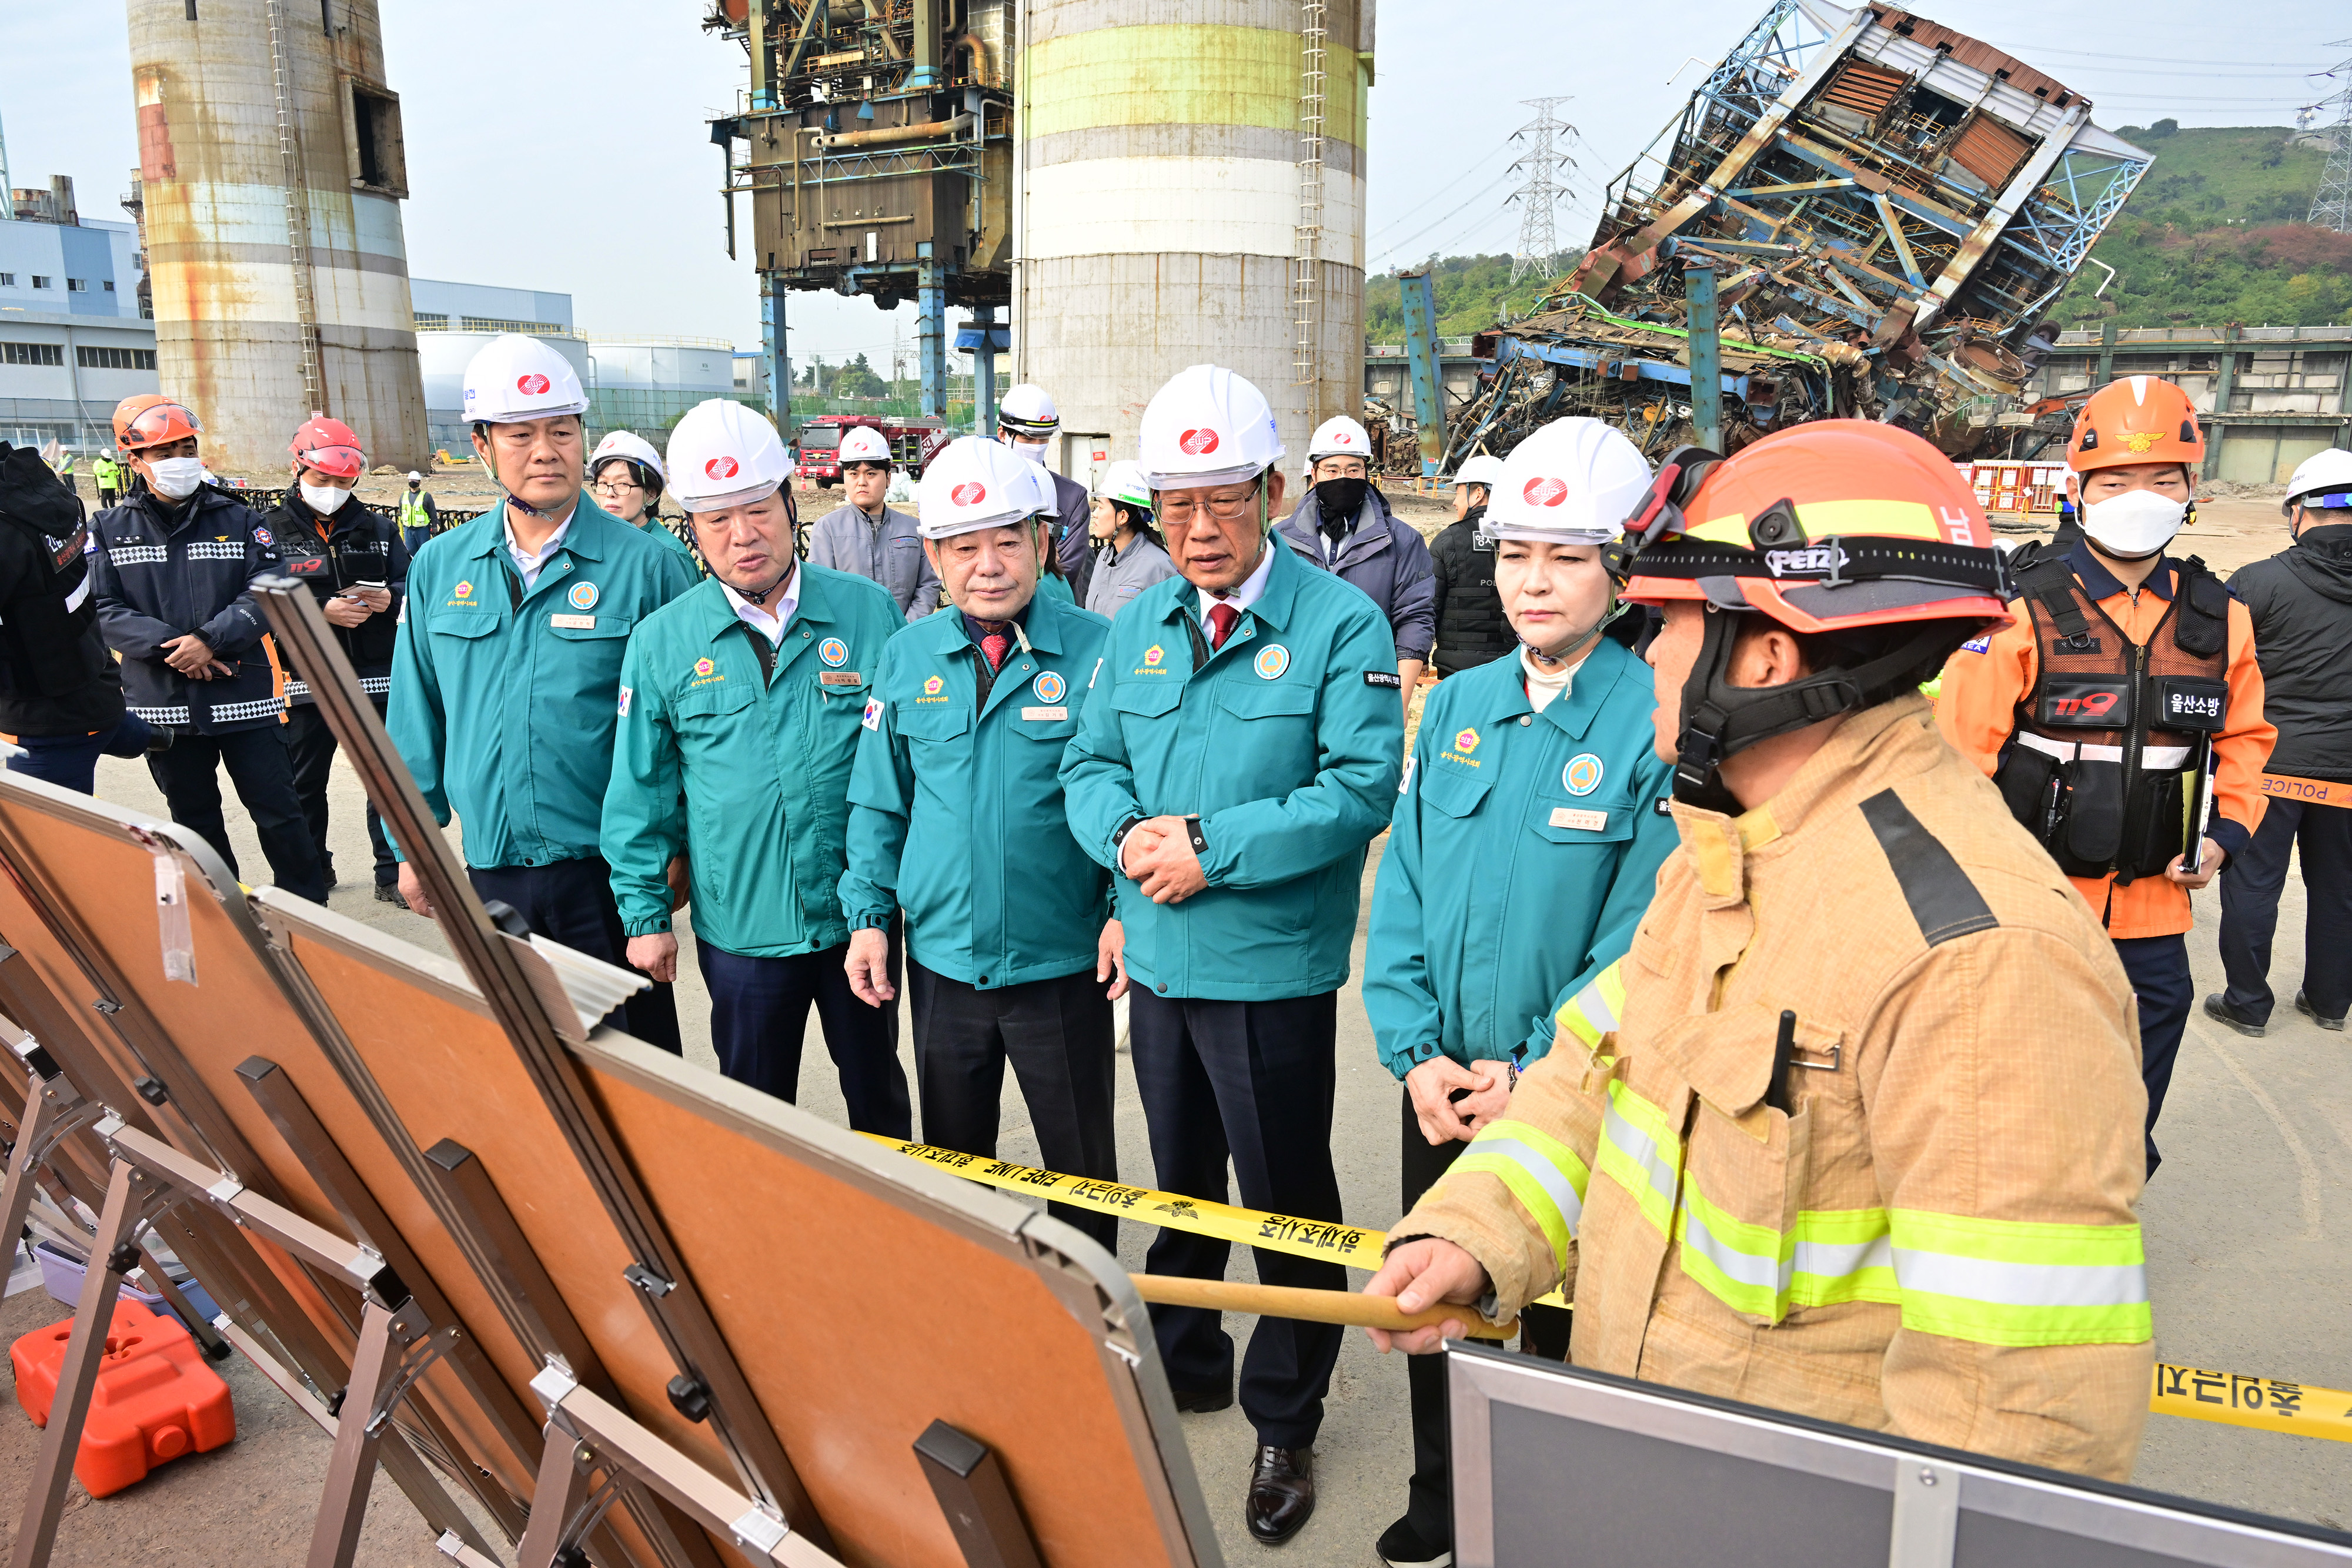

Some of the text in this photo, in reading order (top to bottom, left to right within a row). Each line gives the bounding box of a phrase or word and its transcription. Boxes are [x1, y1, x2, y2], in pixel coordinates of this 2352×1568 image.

[524, 380, 544, 389] EWP
[1187, 436, 1212, 446] EWP
[711, 463, 733, 473] EWP
[957, 489, 980, 499] EWP
[1531, 486, 1560, 497] EWP
[290, 559, 322, 573] 119
[239, 609, 258, 626] GORE-TEX
[1962, 643, 1981, 651] REA
[1367, 673, 1400, 686] 울산광역시 의회
[2054, 692, 2118, 717] 119
[2171, 693, 2220, 717] 울산소방
[1459, 736, 1474, 745] 의회
[2260, 778, 2328, 800] POLICE
[983, 1161, 1030, 1179] LINE
[1019, 1169, 1067, 1188] FIRE
[1068, 1179, 1149, 1209] 출입금지
[1258, 1215, 1367, 1254] 화재조사중
[2157, 1363, 2304, 1417] 출입금지
